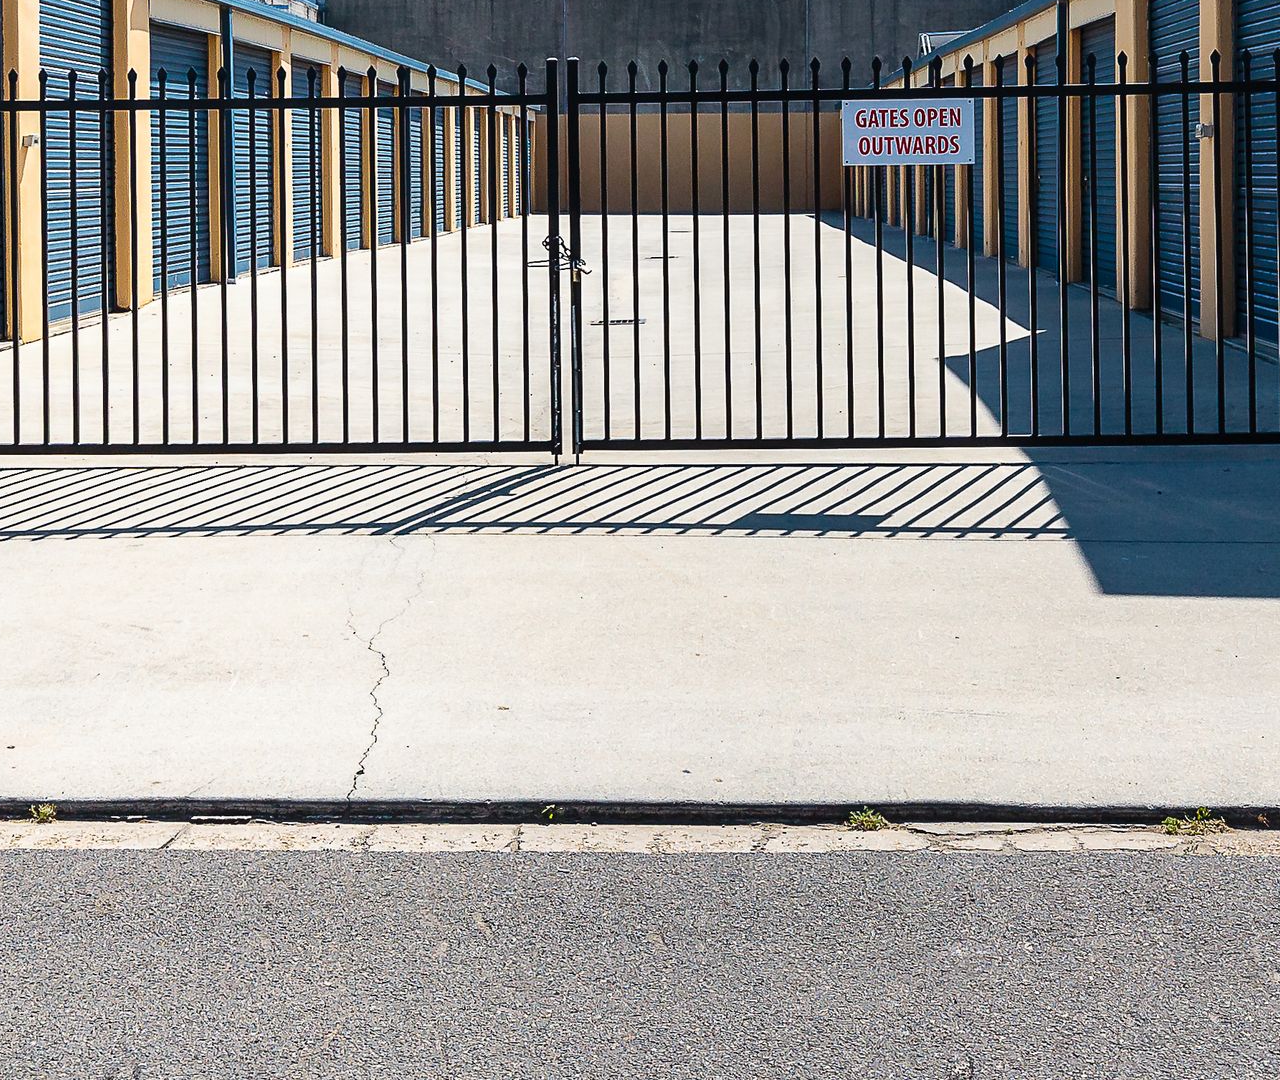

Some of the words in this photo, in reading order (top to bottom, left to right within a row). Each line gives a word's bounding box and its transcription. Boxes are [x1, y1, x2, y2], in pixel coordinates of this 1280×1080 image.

[855, 108, 910, 128] GATES
[913, 107, 961, 127] OPEN
[858, 134, 960, 156] OUTWARDS
